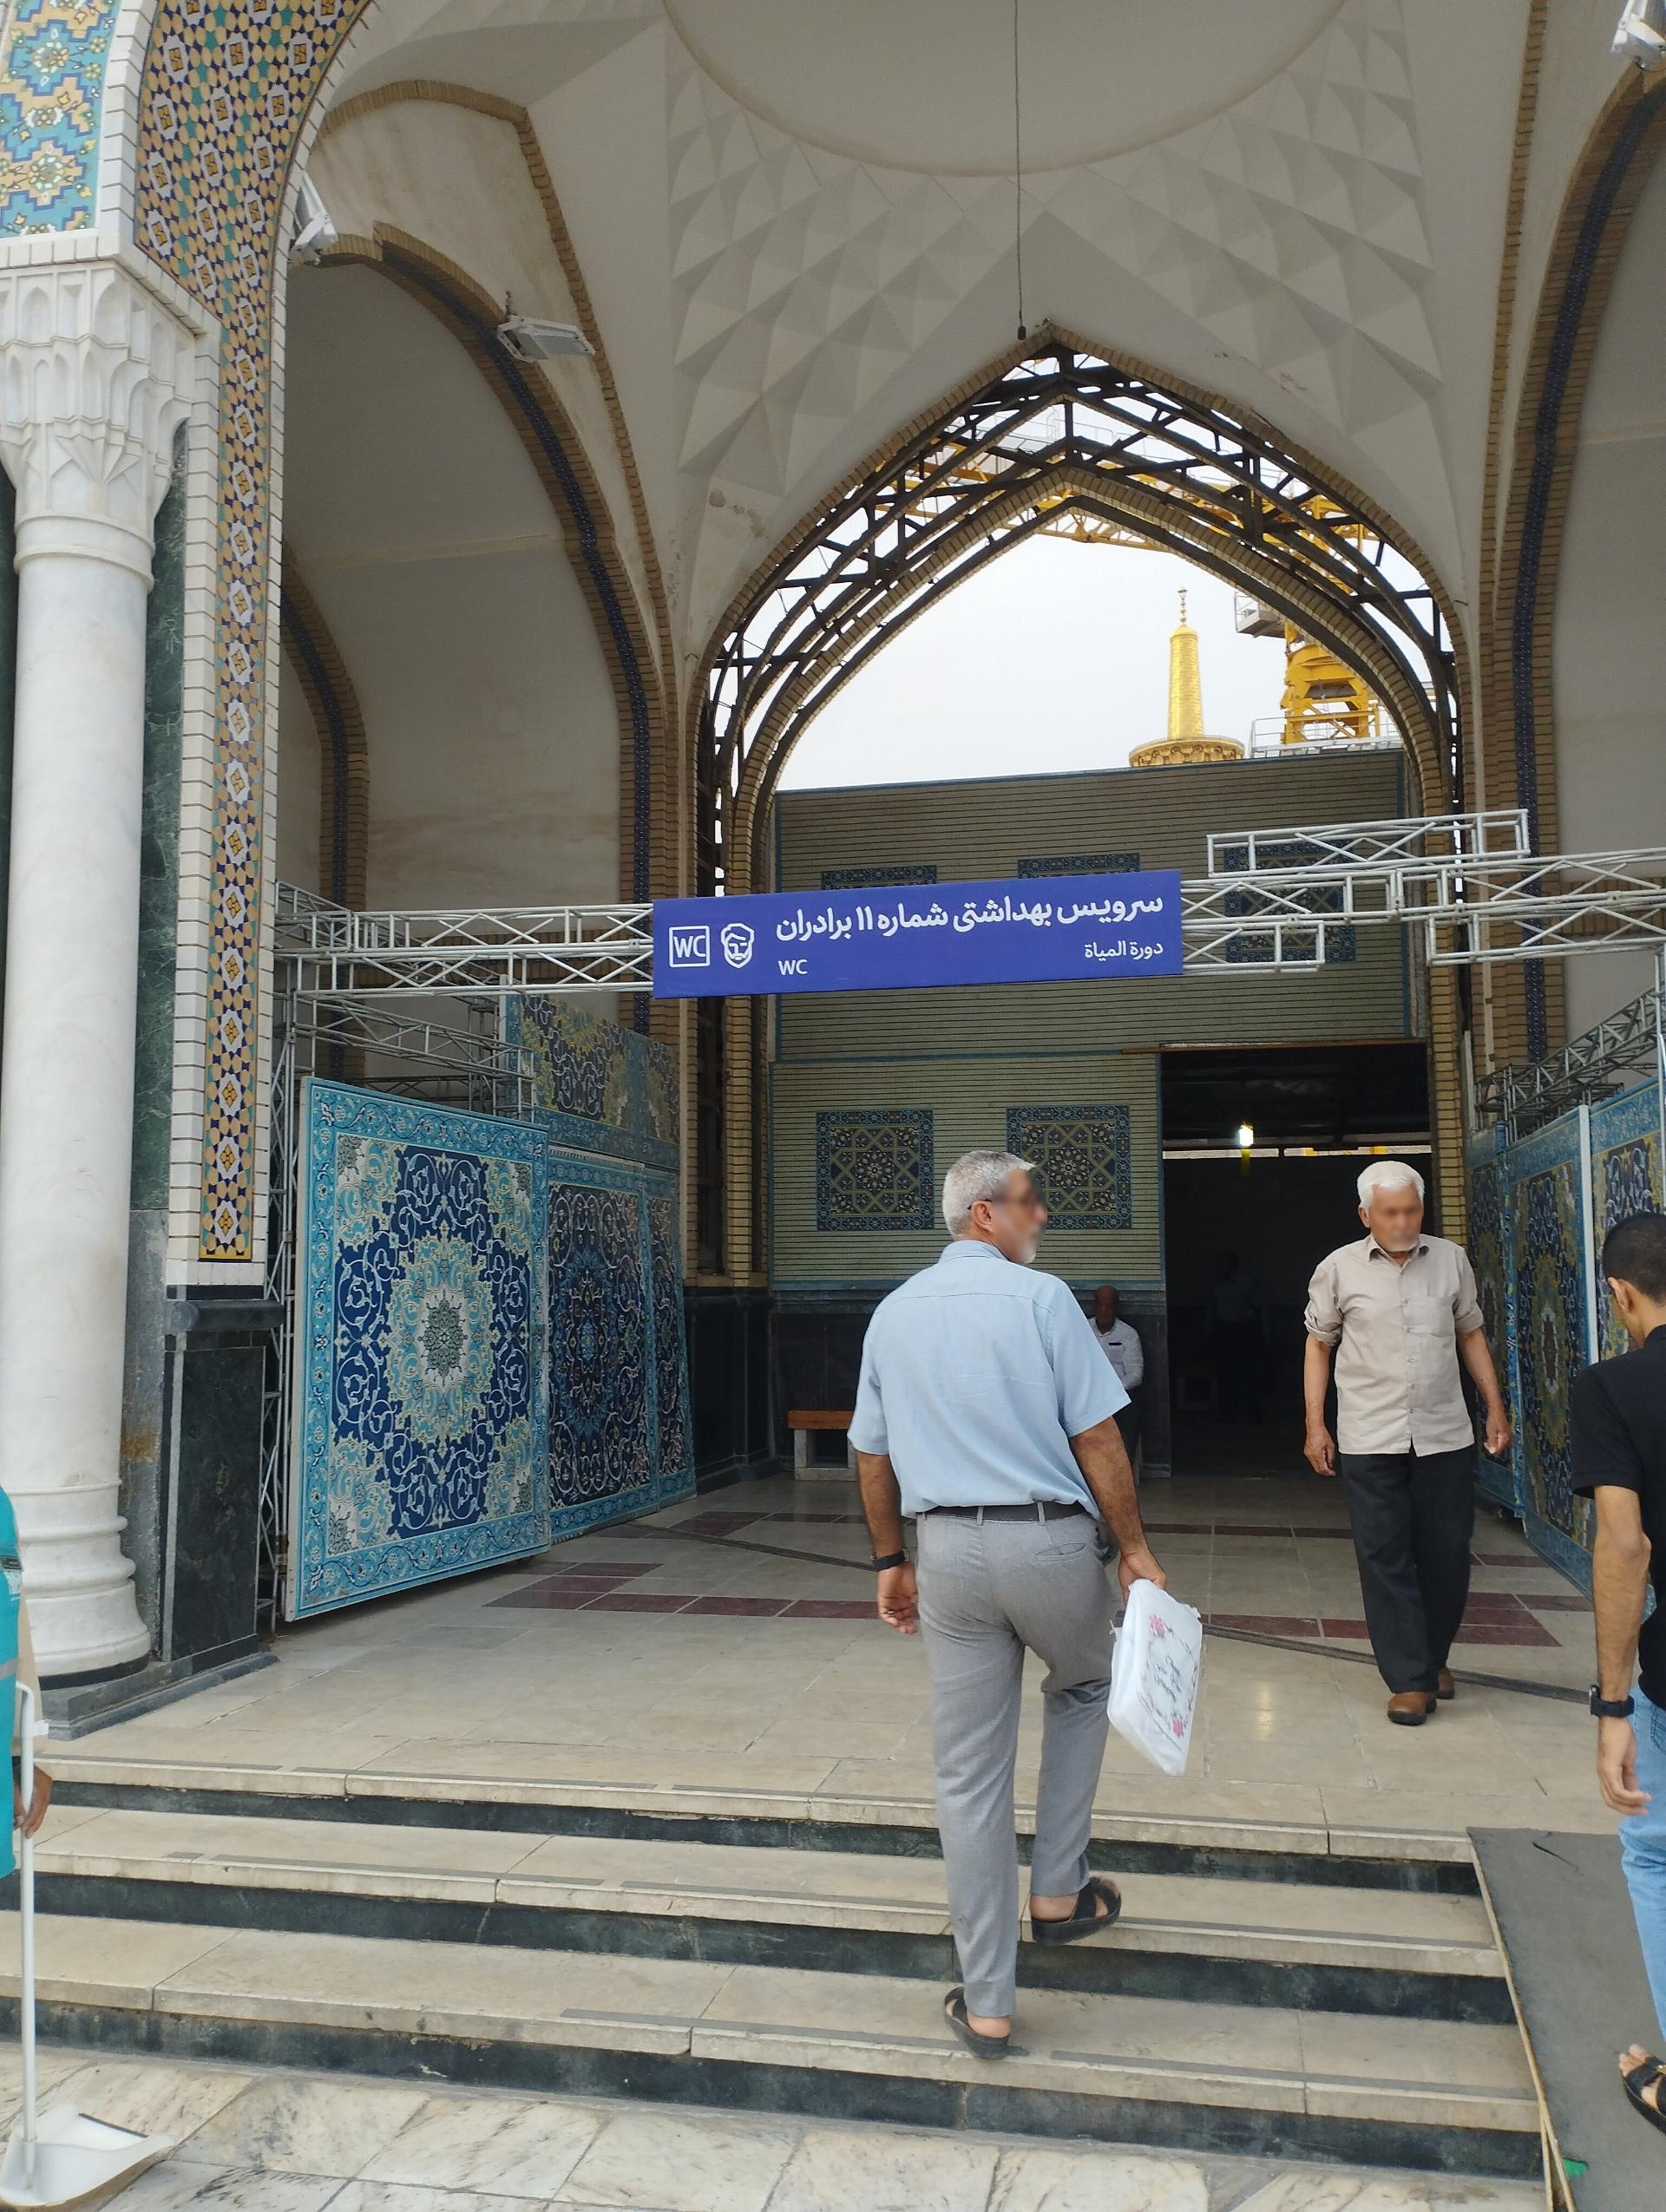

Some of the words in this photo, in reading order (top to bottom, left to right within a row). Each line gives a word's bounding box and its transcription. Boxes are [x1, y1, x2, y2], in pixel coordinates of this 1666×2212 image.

[776, 907, 852, 941] برادران
[877, 902, 949, 937] شماره
[953, 895, 1053, 933] بهداشتی
[1056, 897, 1164, 925] سرویس
[672, 934, 706, 959] WC
[1129, 940, 1164, 960] دورة
[777, 959, 808, 976] WC
